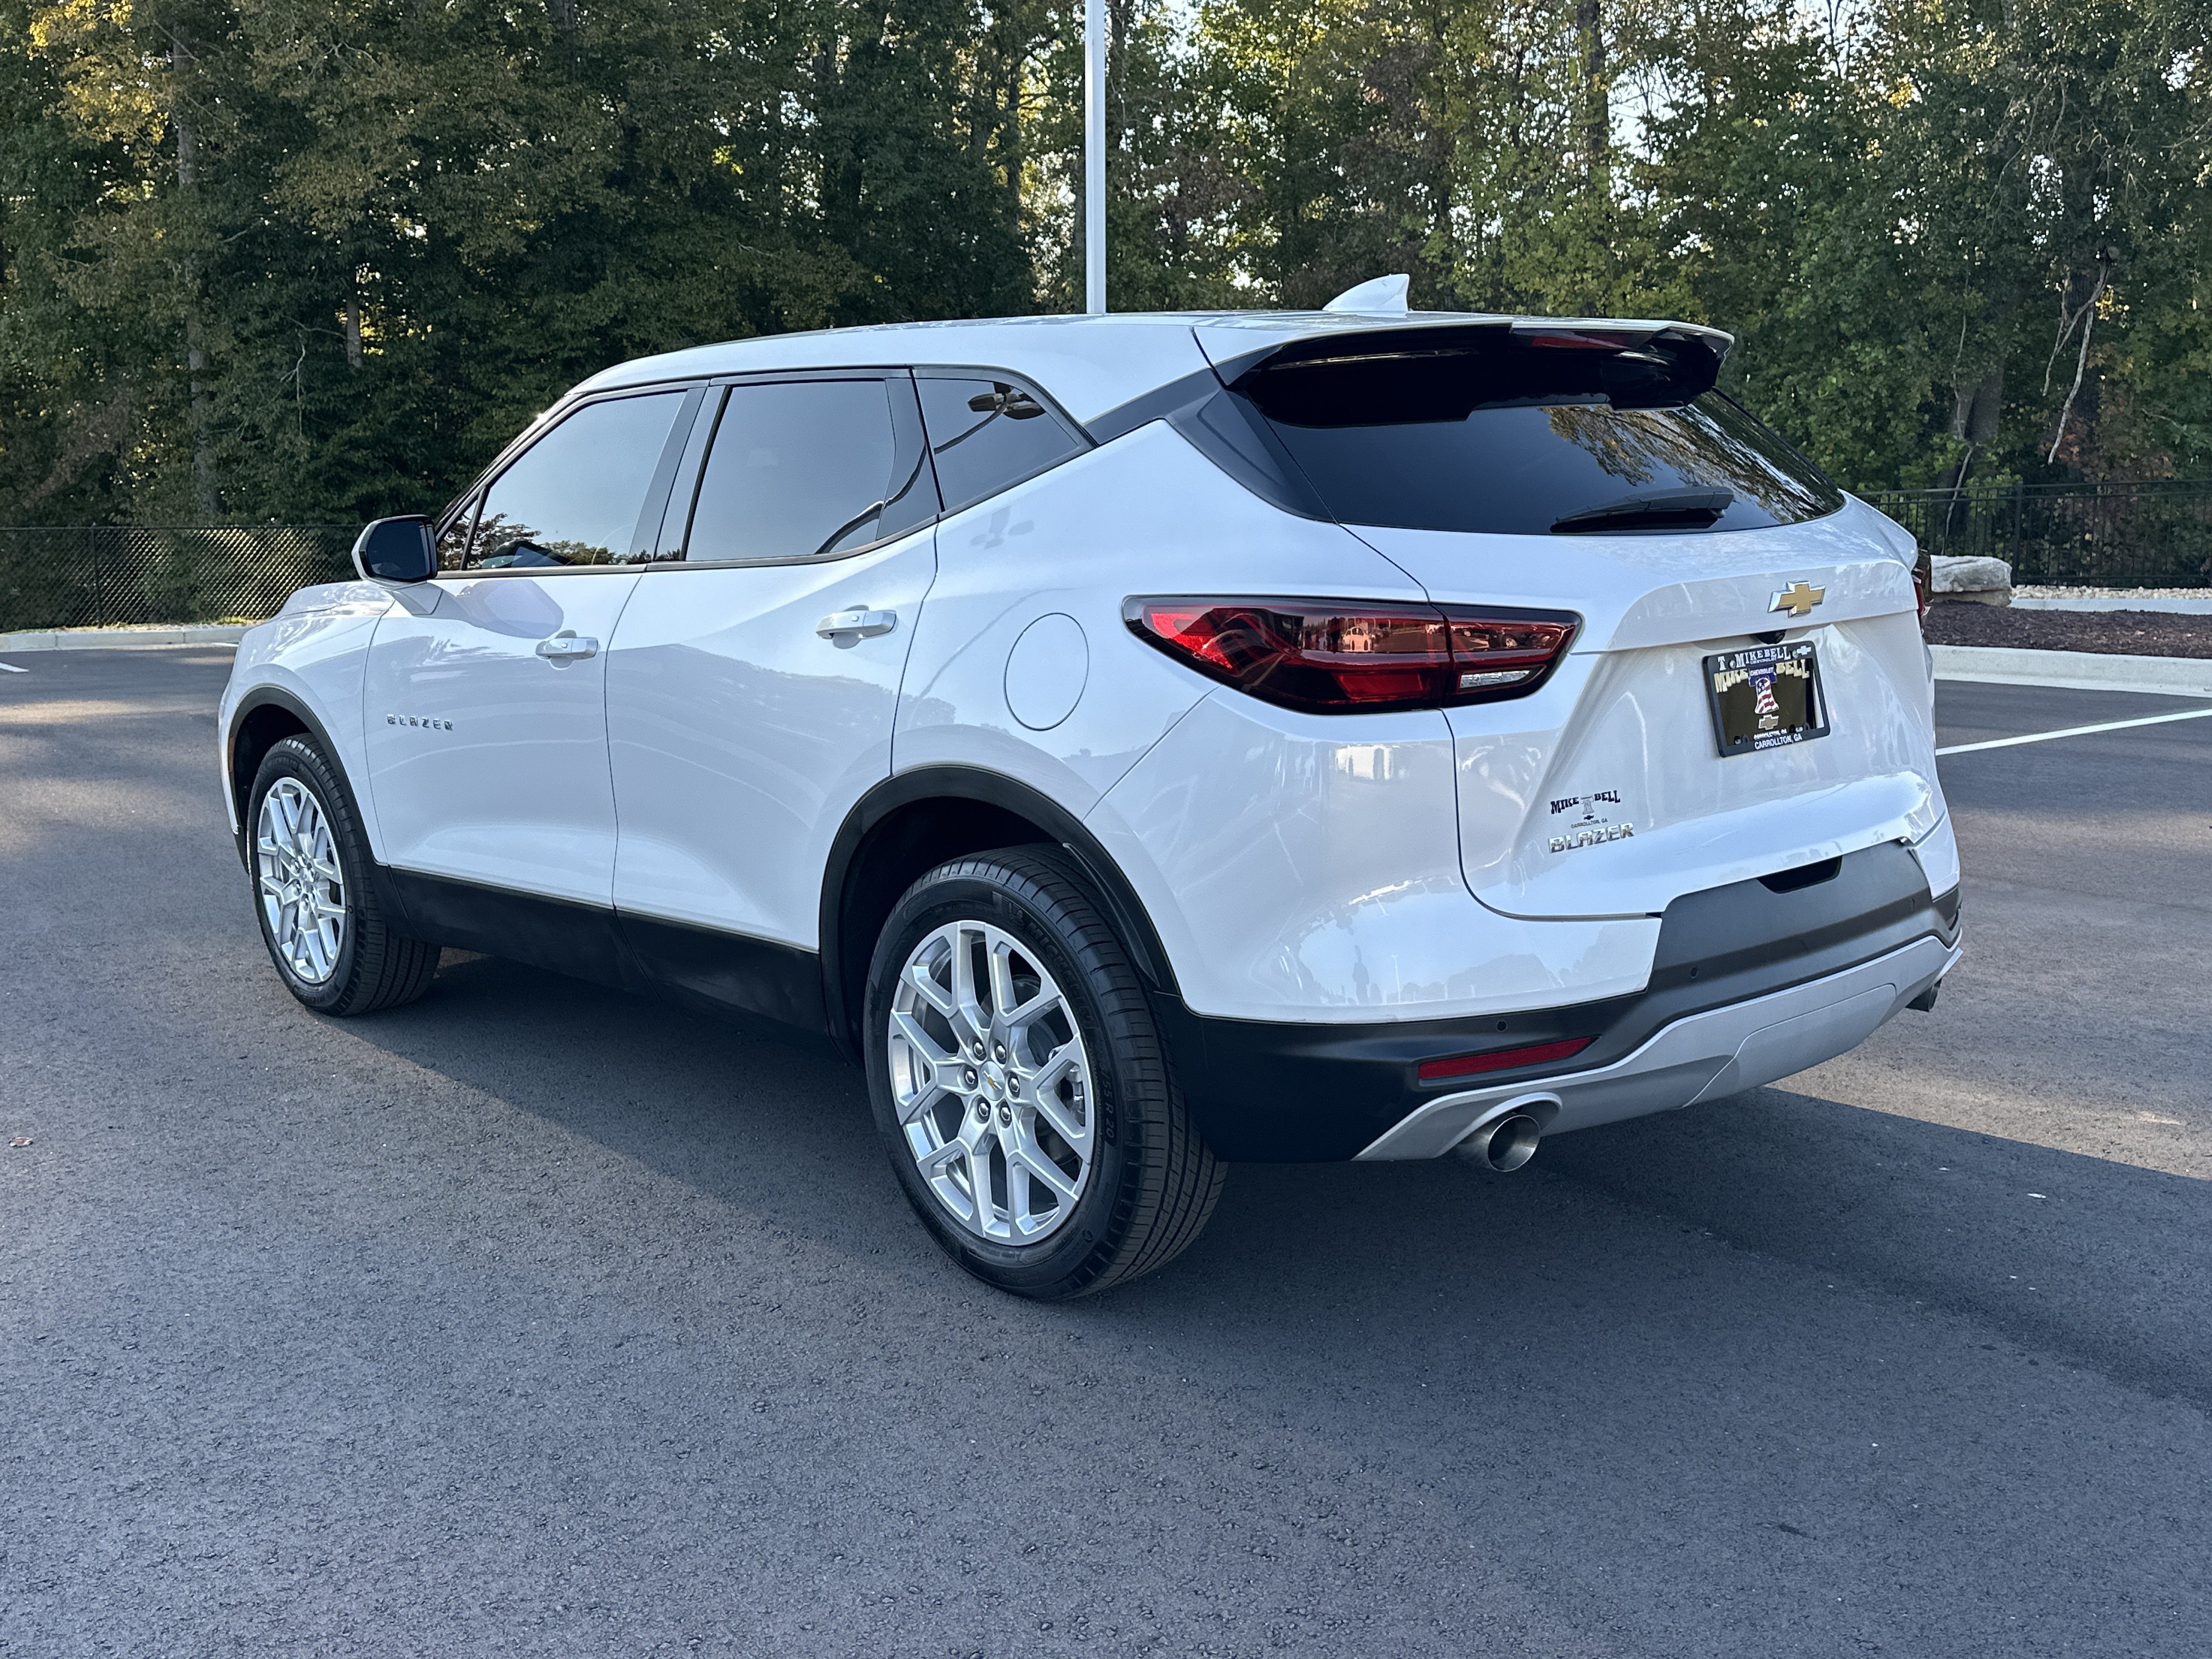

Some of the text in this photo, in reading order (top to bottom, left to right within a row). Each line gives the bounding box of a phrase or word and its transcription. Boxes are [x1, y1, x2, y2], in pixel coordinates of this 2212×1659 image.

[1735, 646, 1791, 668] MIKE BELL
[1714, 659, 1810, 693] MIKE BELL
[387, 714, 453, 731] BLAZER
[1754, 733, 1802, 749] CARROLLTON, GA
[1550, 790, 1621, 814] MIKE BELL
[1548, 822, 1634, 854] BLAZER
[1106, 1118, 1114, 1139] 20
